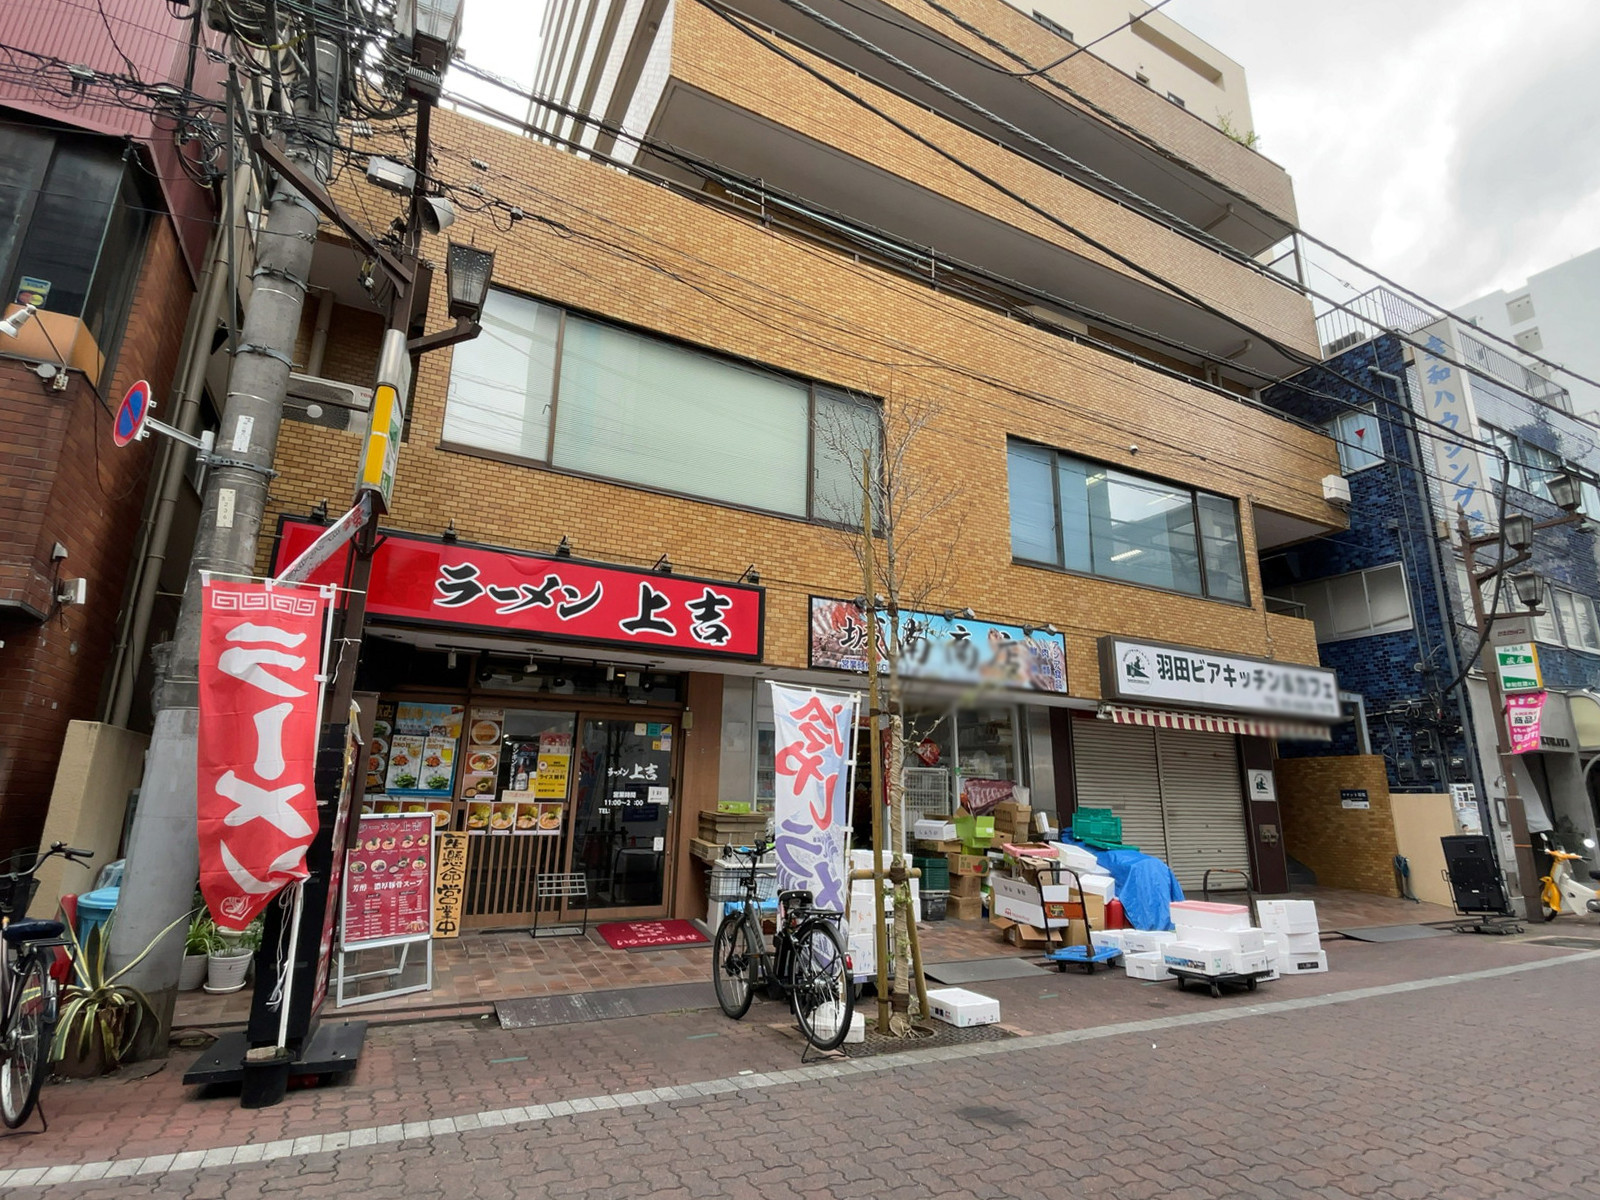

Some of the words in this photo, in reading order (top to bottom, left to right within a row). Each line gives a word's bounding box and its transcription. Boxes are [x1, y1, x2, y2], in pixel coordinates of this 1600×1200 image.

[433, 562, 603, 621] ラーメン
[618, 581, 733, 646] 上吉
[629, 762, 659, 781] 上吉
[435, 833, 466, 935] 一生懸命営業中
